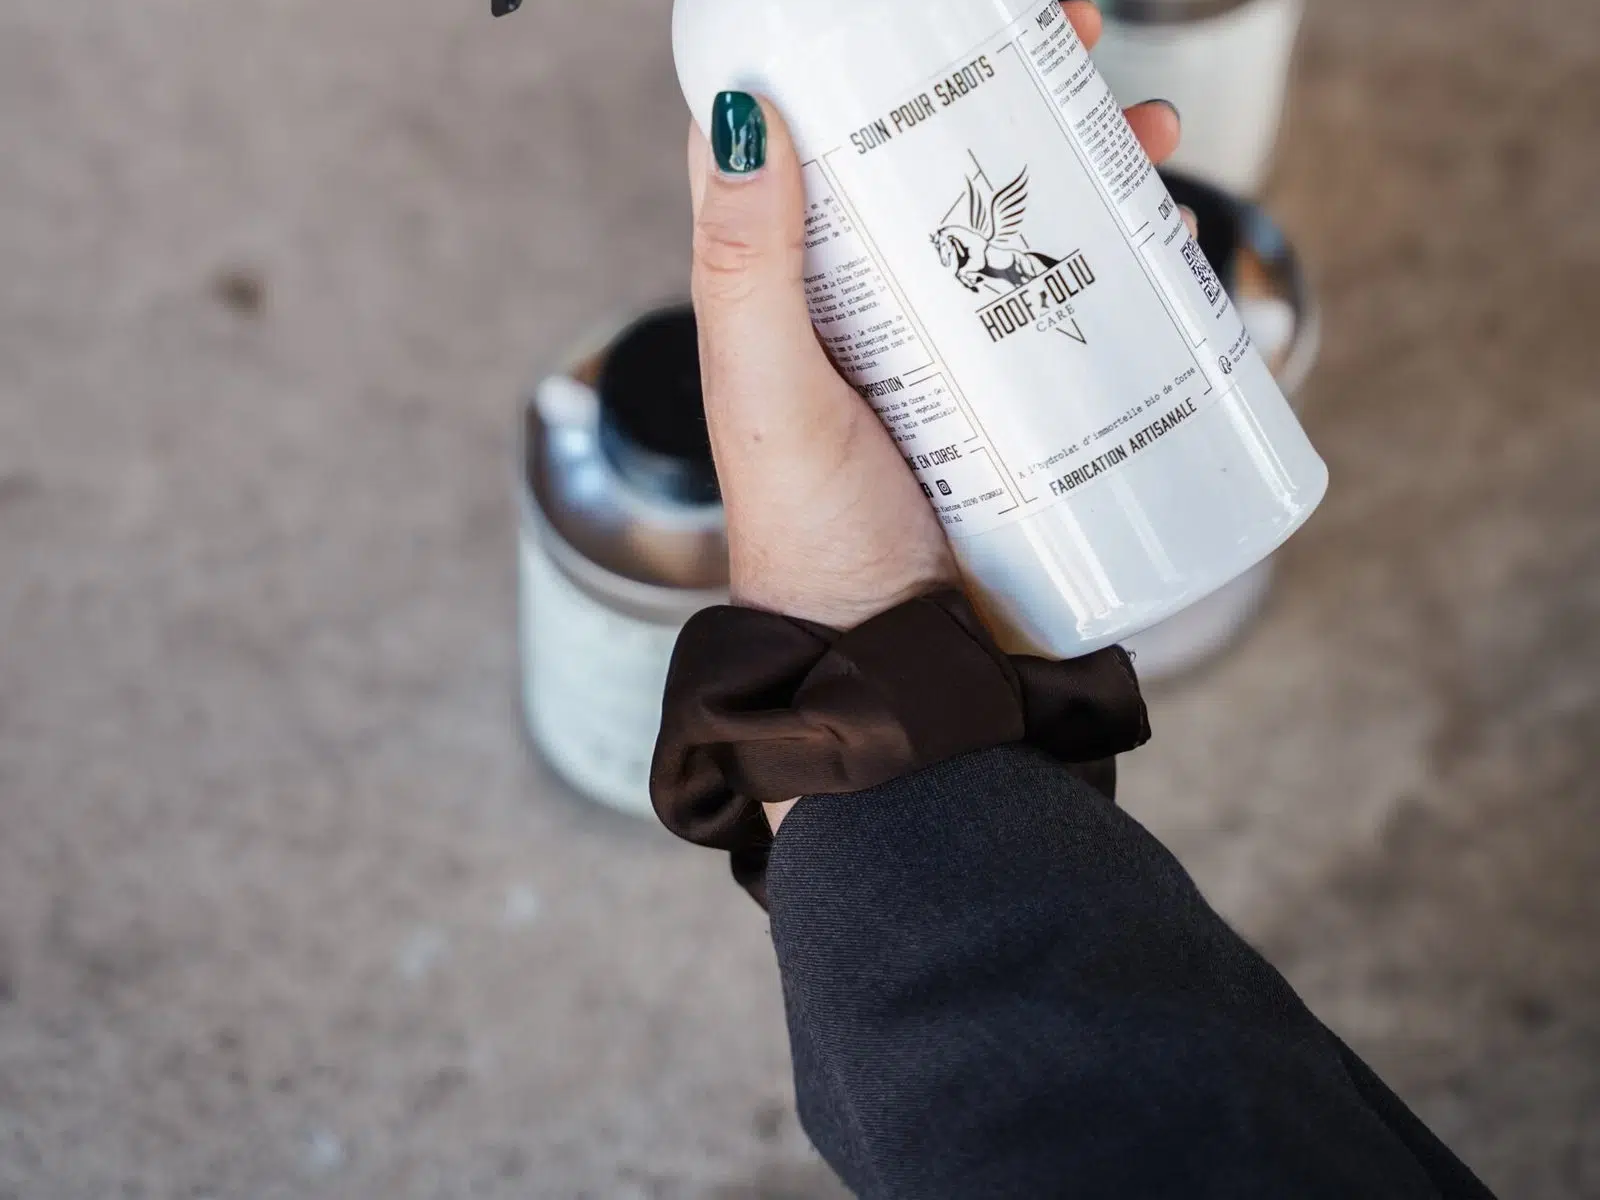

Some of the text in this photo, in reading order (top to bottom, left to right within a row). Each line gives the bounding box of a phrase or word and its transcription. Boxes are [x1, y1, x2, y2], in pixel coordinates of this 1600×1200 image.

[850, 54, 995, 155] SOIN POUR SABOTS
[979, 254, 1096, 342] HOOF OLIU
[1036, 304, 1075, 333] CARE
[909, 395, 926, 405] Corse
[1027, 444, 1079, 474] l'hydrolat
[1082, 405, 1143, 447] d'immortelle
[1144, 393, 1161, 408] bio
[1163, 384, 1173, 395] de
[1174, 366, 1196, 386] Corse
[916, 453, 932, 470] EN
[929, 443, 963, 466] CORSE
[1048, 396, 1197, 496] FABRICATION ARTISANALE
